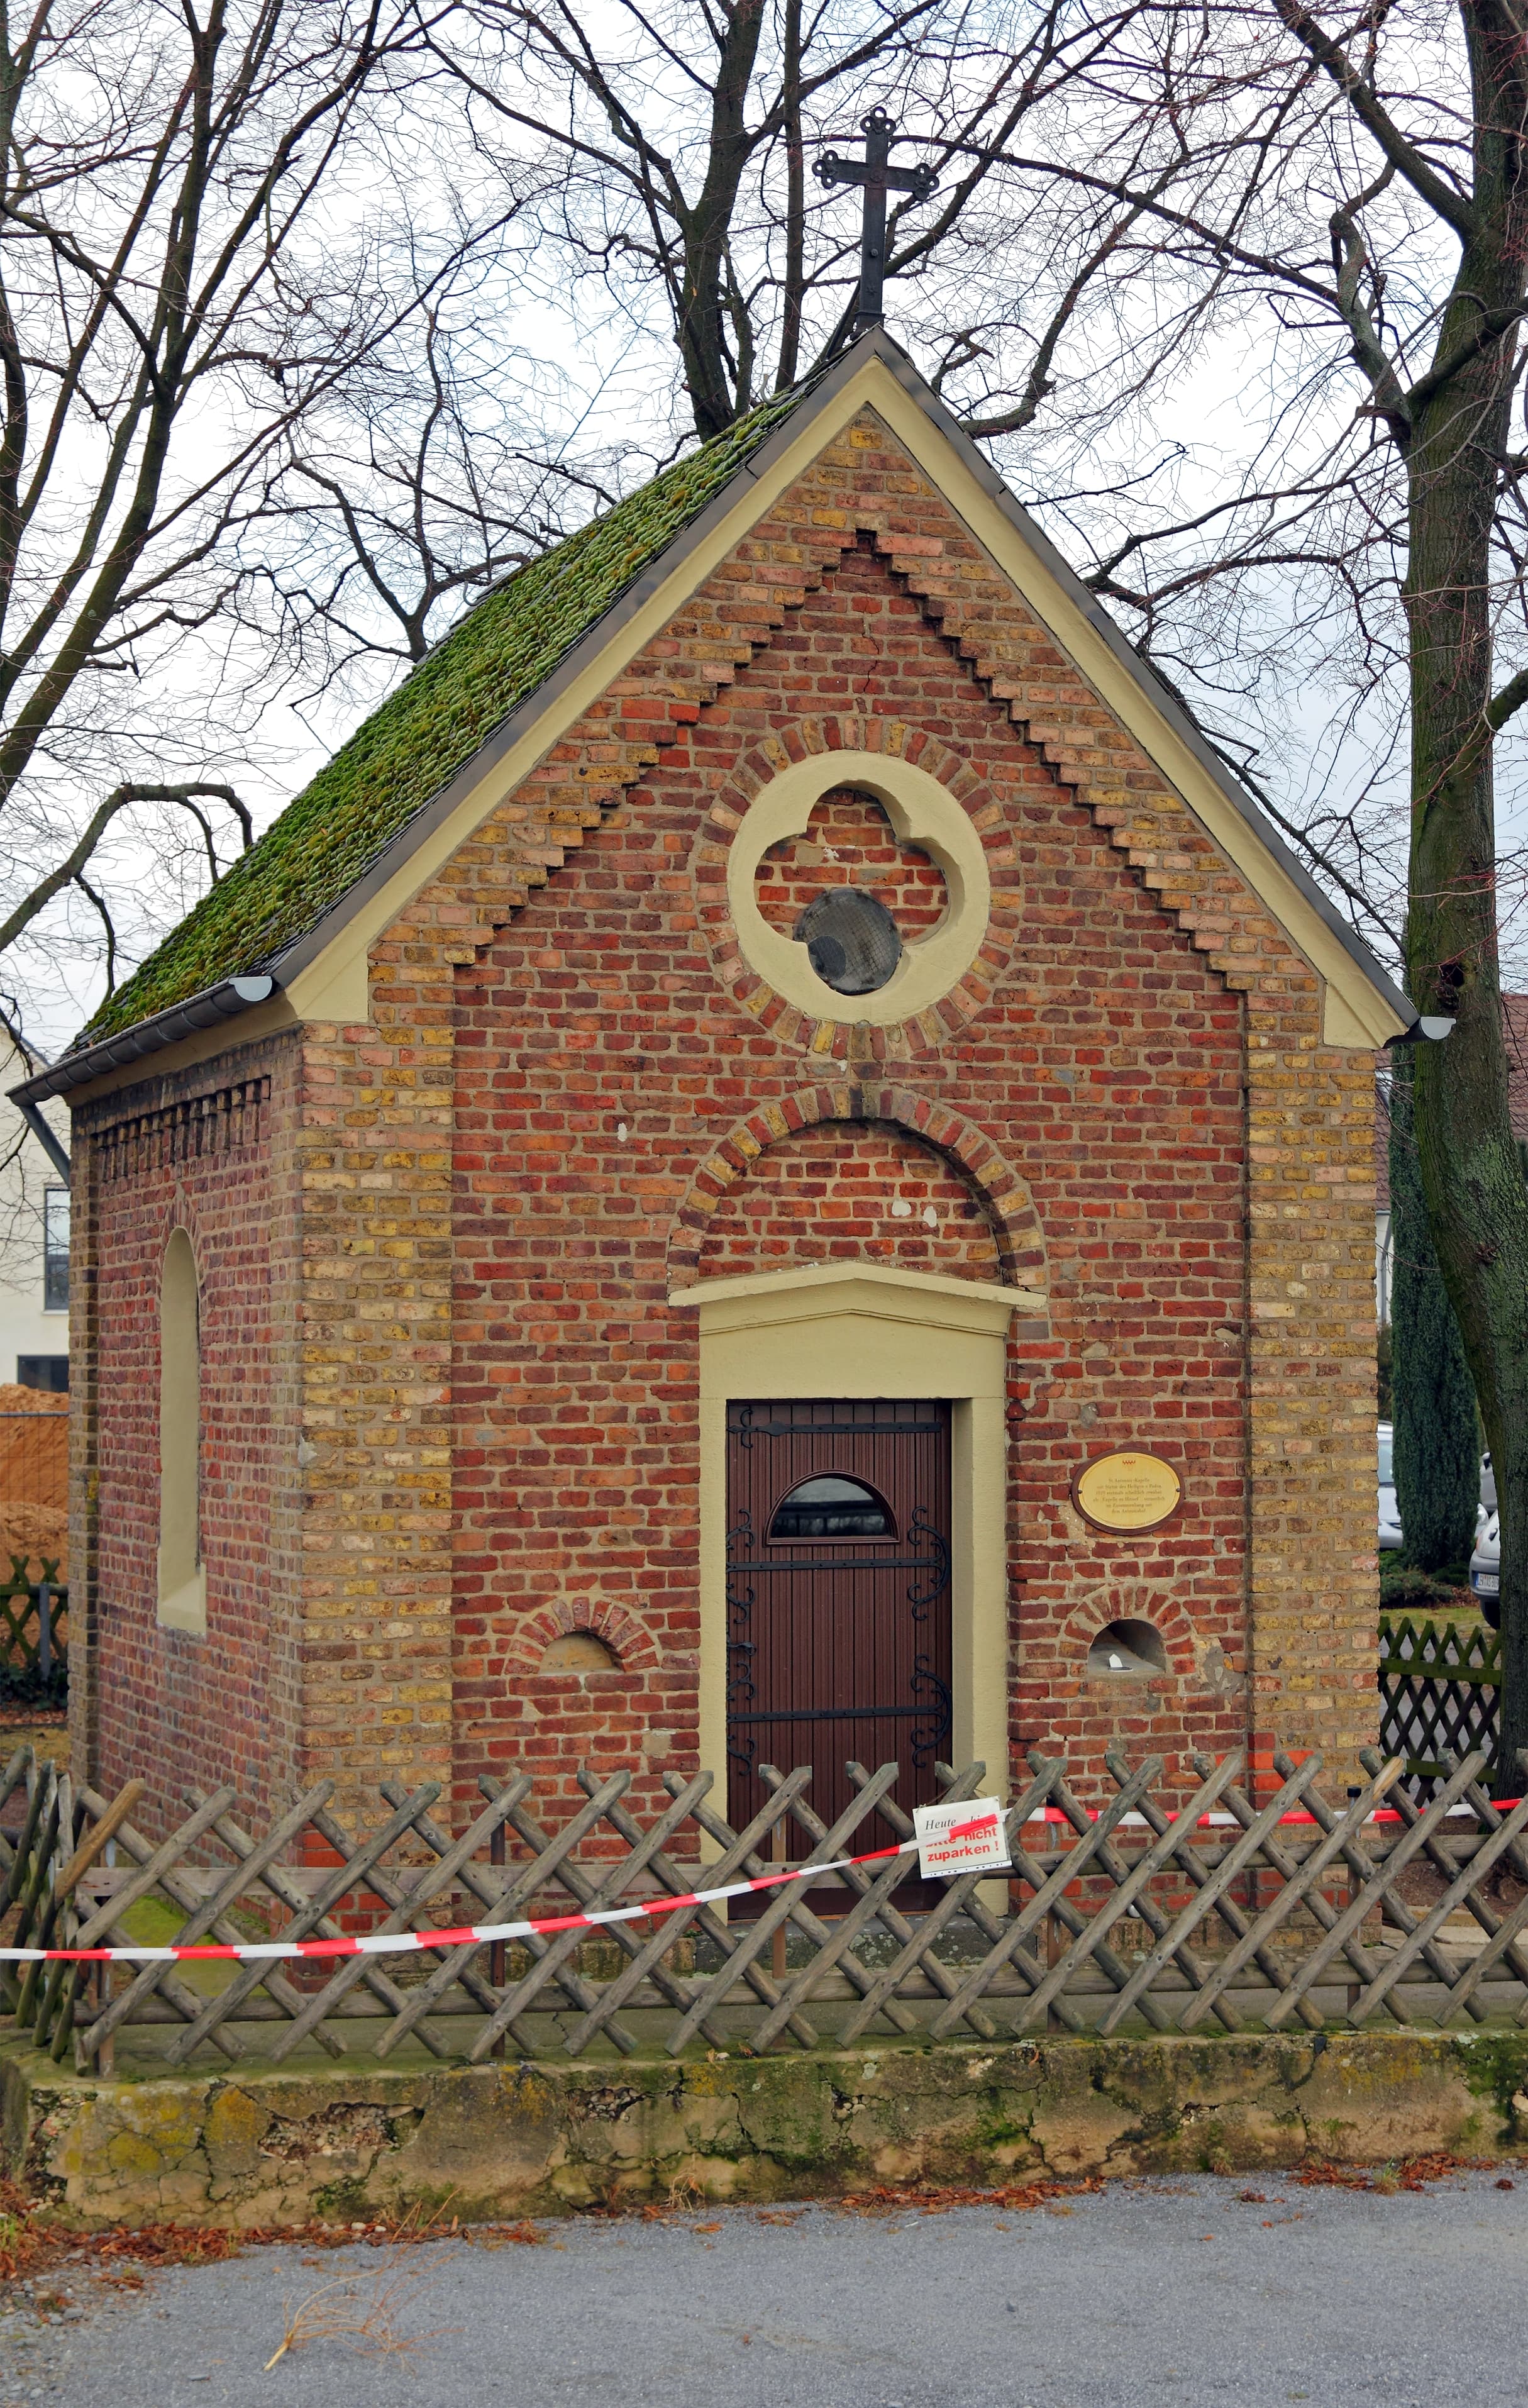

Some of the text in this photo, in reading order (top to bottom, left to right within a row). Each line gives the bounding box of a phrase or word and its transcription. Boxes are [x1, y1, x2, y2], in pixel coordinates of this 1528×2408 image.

[926, 1819, 956, 1830] Heute
[965, 1827, 997, 1841] nicht
[927, 1845, 990, 1862] zuparken
